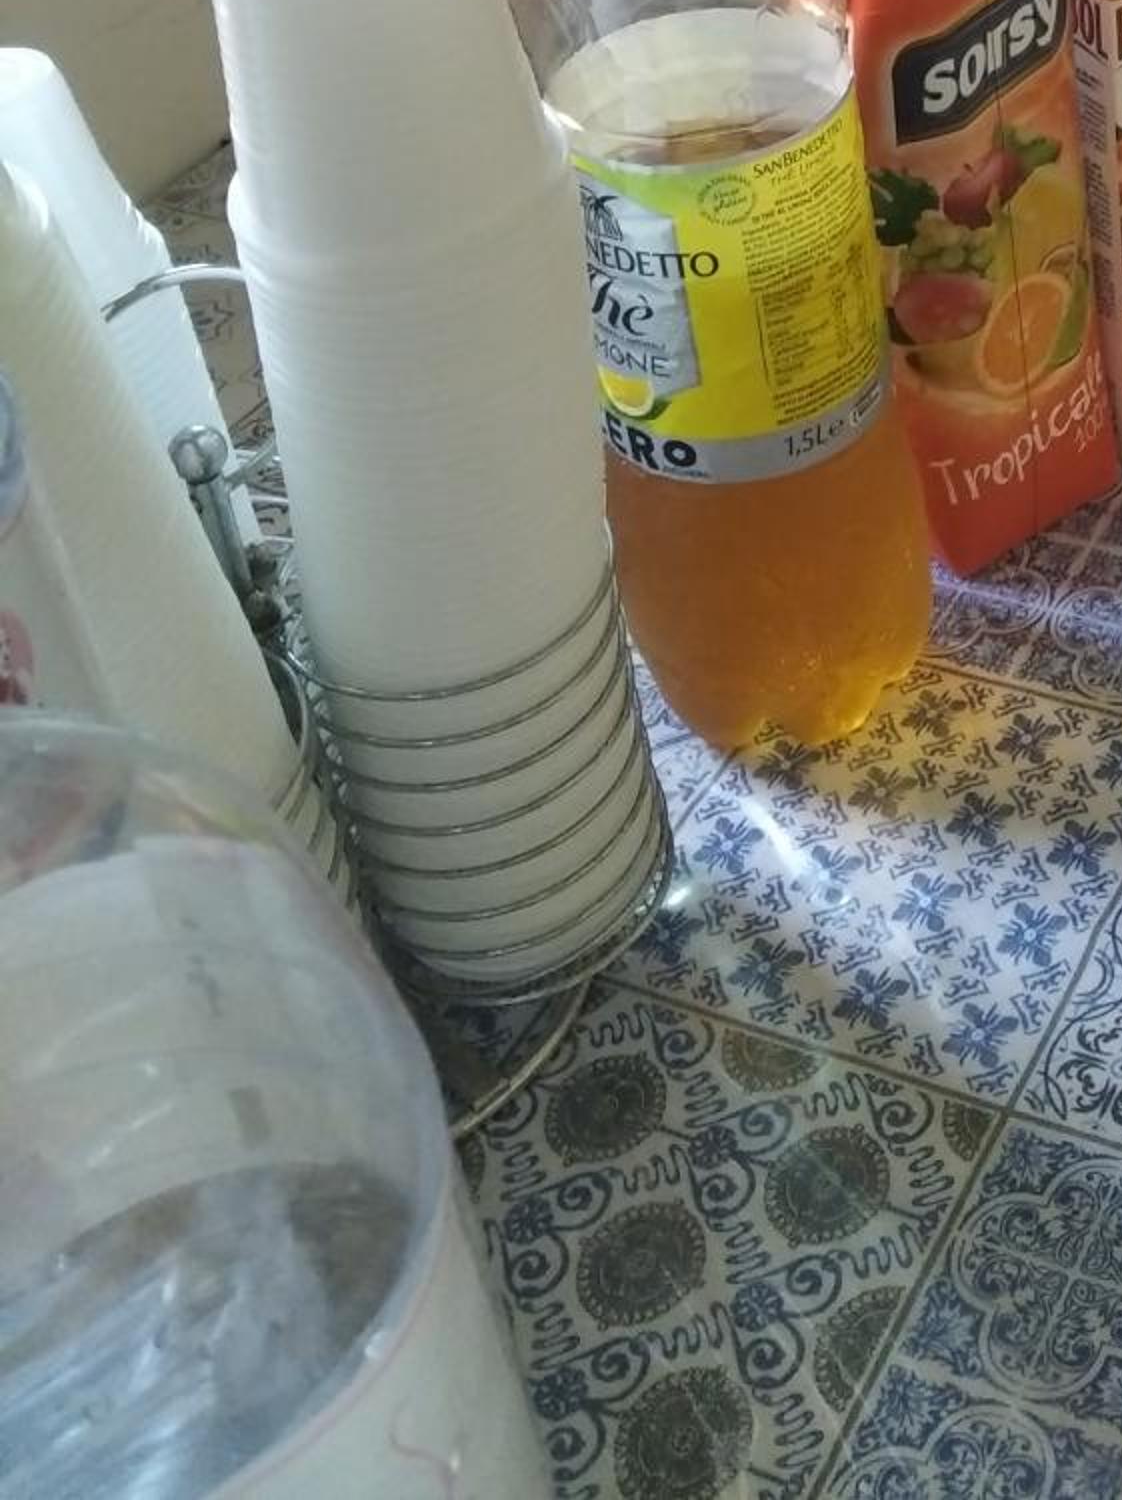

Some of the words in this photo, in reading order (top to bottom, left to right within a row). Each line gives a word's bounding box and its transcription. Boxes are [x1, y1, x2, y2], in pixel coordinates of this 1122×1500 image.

[585, 234, 720, 279] NEDETTO
[594, 334, 671, 379] MONE
[602, 410, 698, 471] ERO
